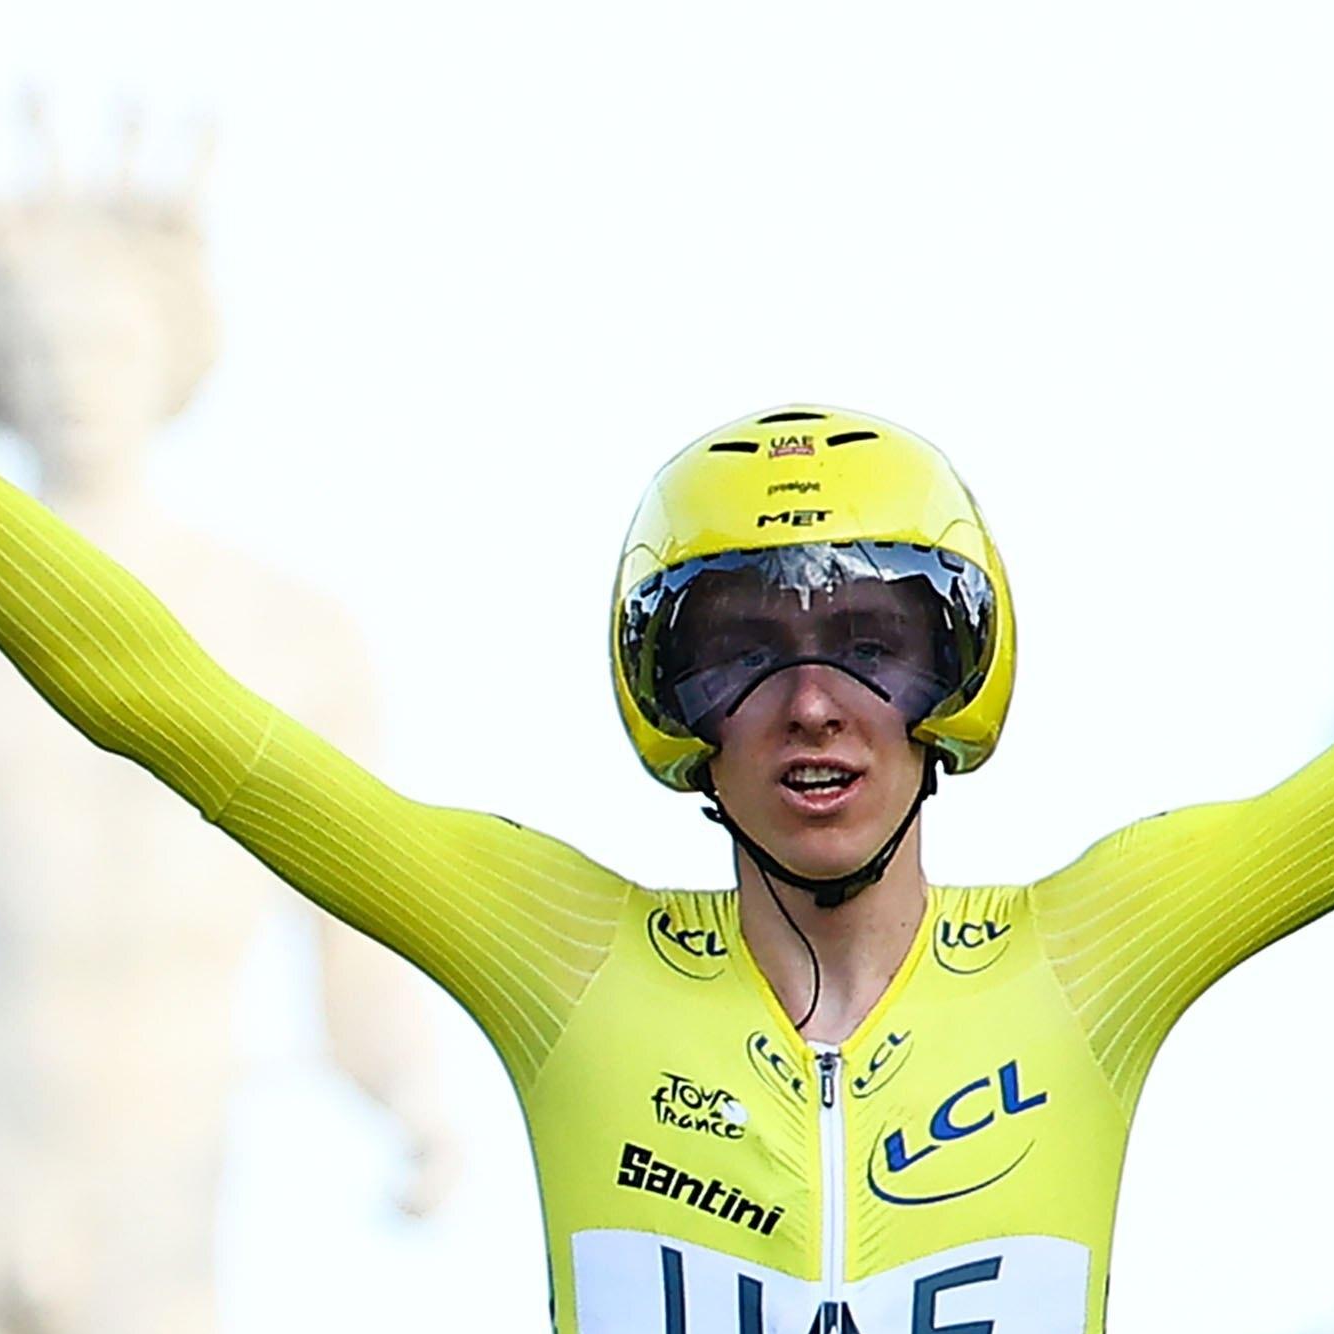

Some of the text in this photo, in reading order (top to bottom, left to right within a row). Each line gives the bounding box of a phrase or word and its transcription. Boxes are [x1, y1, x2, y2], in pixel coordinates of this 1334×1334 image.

[756, 508, 833, 528] MET
[656, 911, 727, 957] LCL
[940, 918, 1011, 948] LCL
[853, 1029, 912, 1091] LCL
[882, 1059, 1048, 1174] LCL
[616, 1142, 786, 1237] Santini
